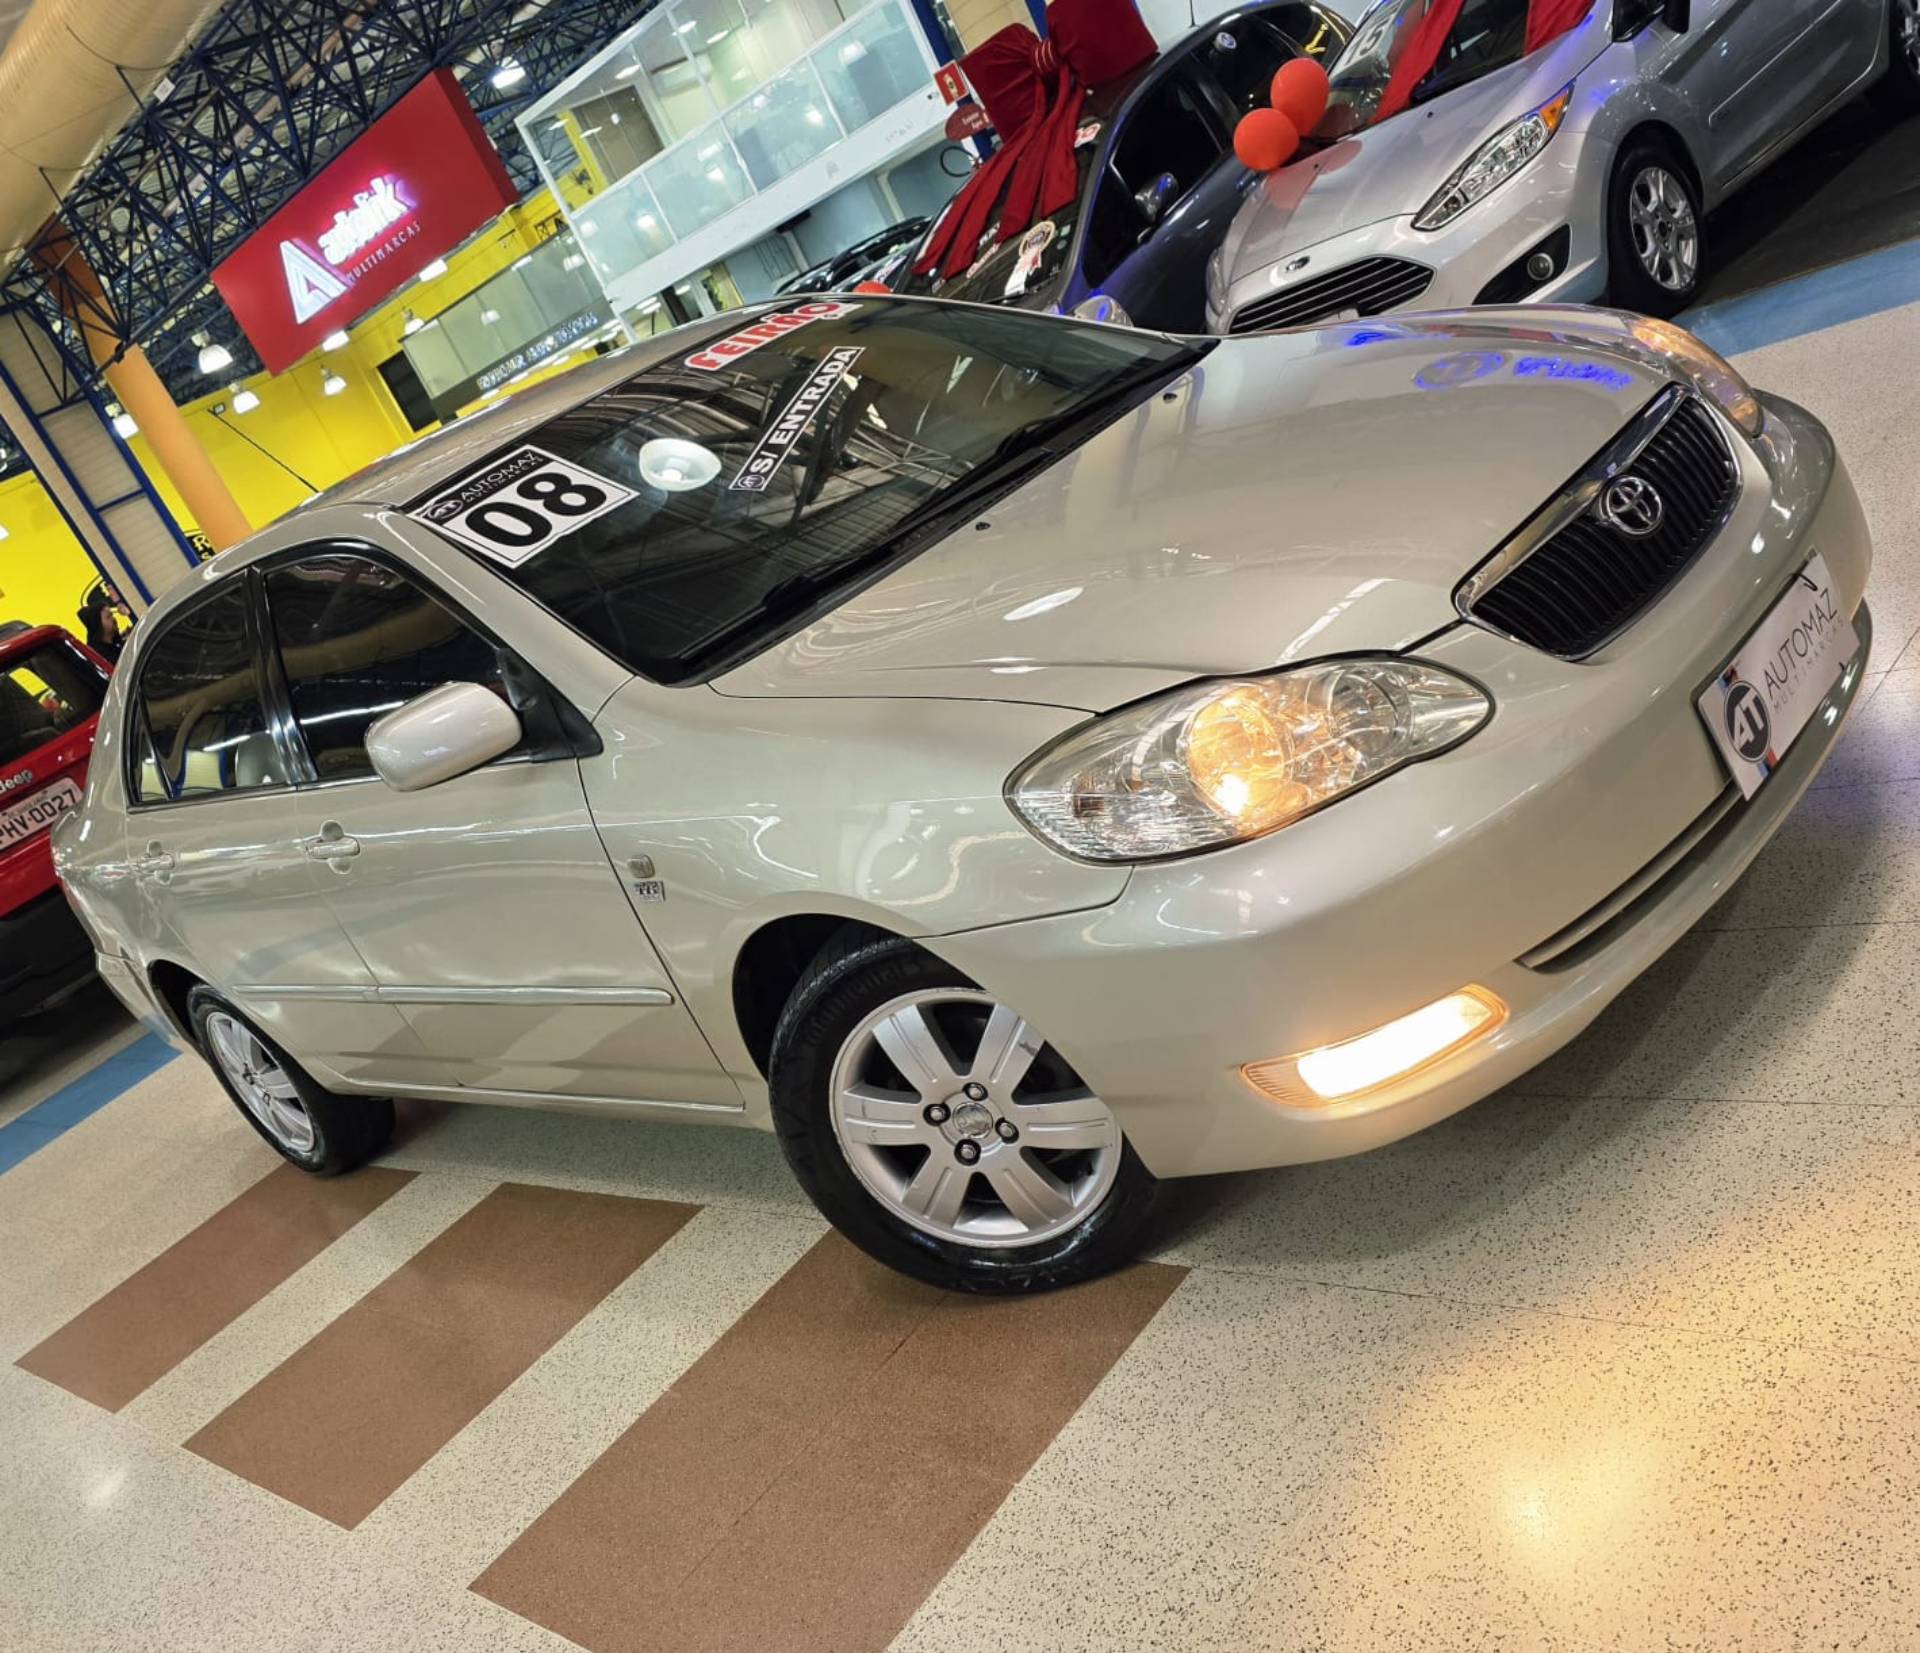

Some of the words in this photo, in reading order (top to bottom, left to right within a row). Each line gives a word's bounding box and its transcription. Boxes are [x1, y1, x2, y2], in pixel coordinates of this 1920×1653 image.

[346, 220, 421, 283] MULTIMARCAS
[689, 302, 842, 369] FEIRÃO
[768, 350, 857, 445] ENTRADA
[465, 472, 607, 547] 08
[1763, 588, 1838, 697] AUTOMAZ
